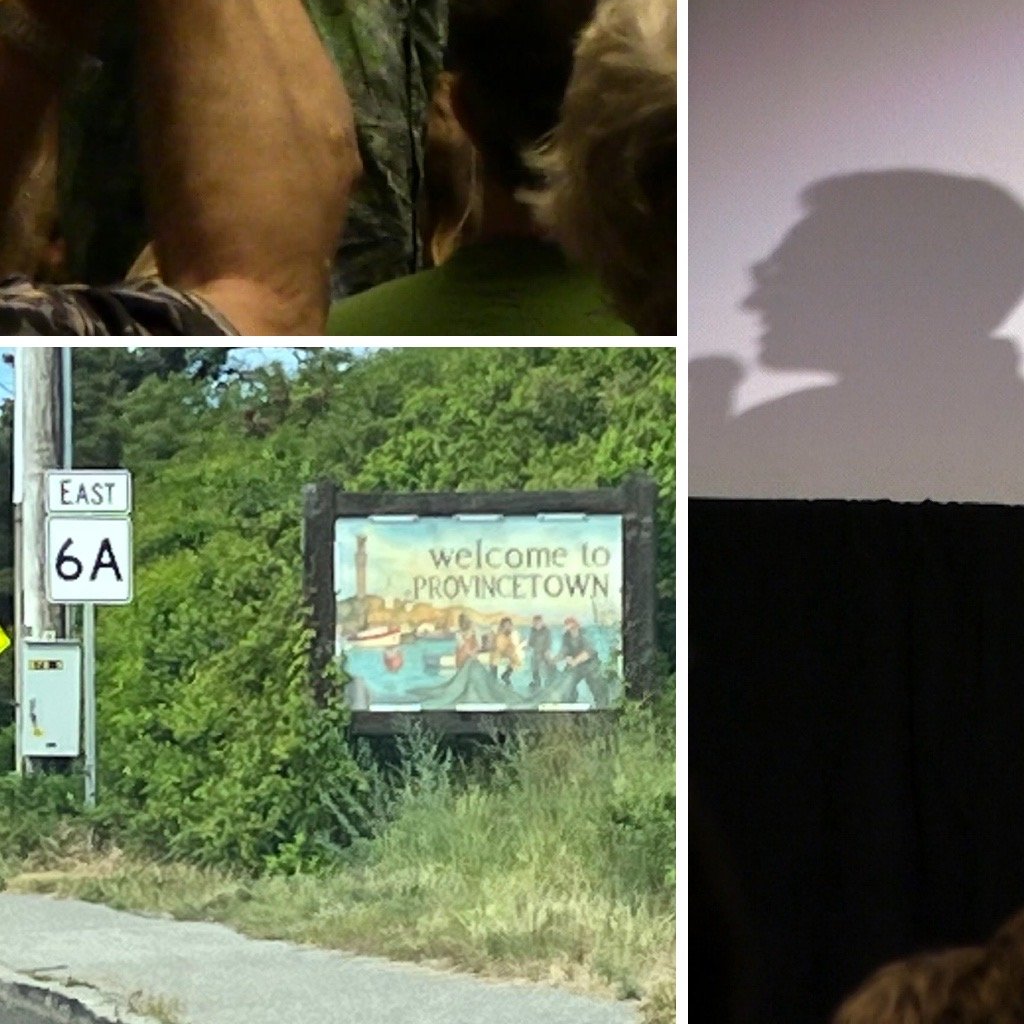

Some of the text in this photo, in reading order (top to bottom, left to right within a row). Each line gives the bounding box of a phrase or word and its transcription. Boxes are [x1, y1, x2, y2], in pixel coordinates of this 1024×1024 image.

[60, 480, 116, 505] EAST
[55, 537, 123, 582] 6A
[429, 538, 611, 570] welcome to
[412, 573, 610, 601] PROVINCETOWN
